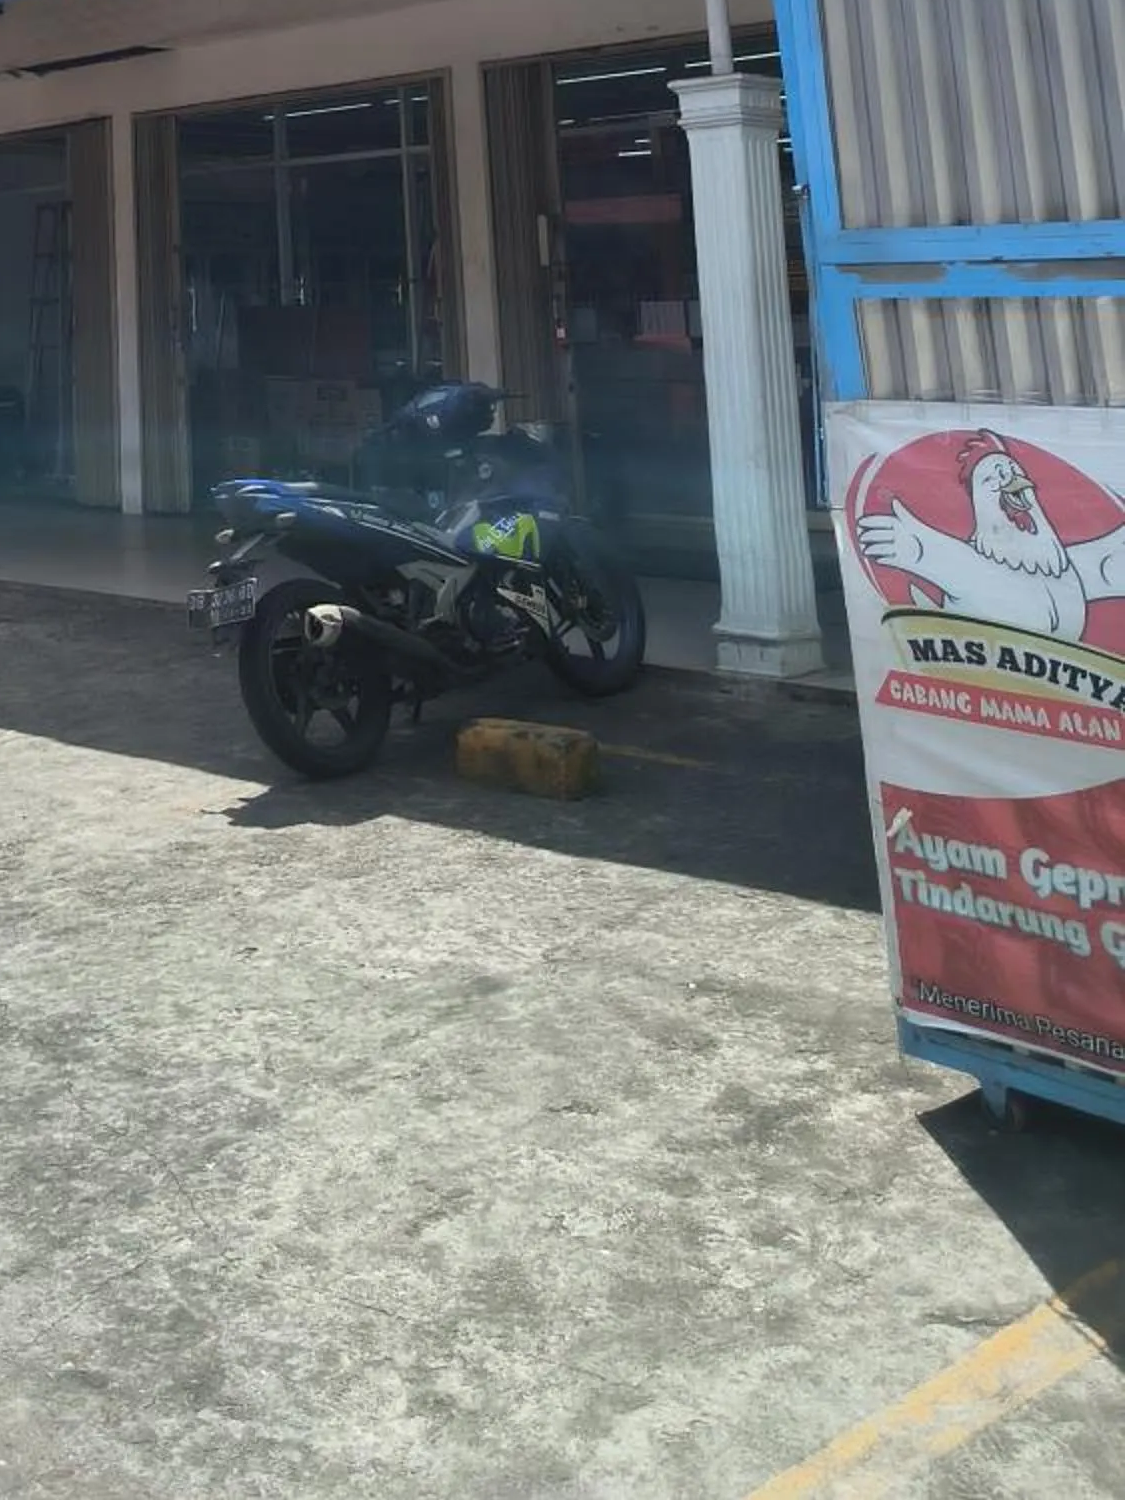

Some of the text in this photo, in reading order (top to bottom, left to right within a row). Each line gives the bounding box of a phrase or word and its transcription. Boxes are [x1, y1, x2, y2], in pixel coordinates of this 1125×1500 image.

[907, 638, 986, 666] MAS
[889, 679, 1122, 742] CABANG MAMA ALAN
[887, 807, 1007, 880] Ayam
[893, 867, 1092, 957] Tindarung
[918, 980, 1032, 1031] Menerima
